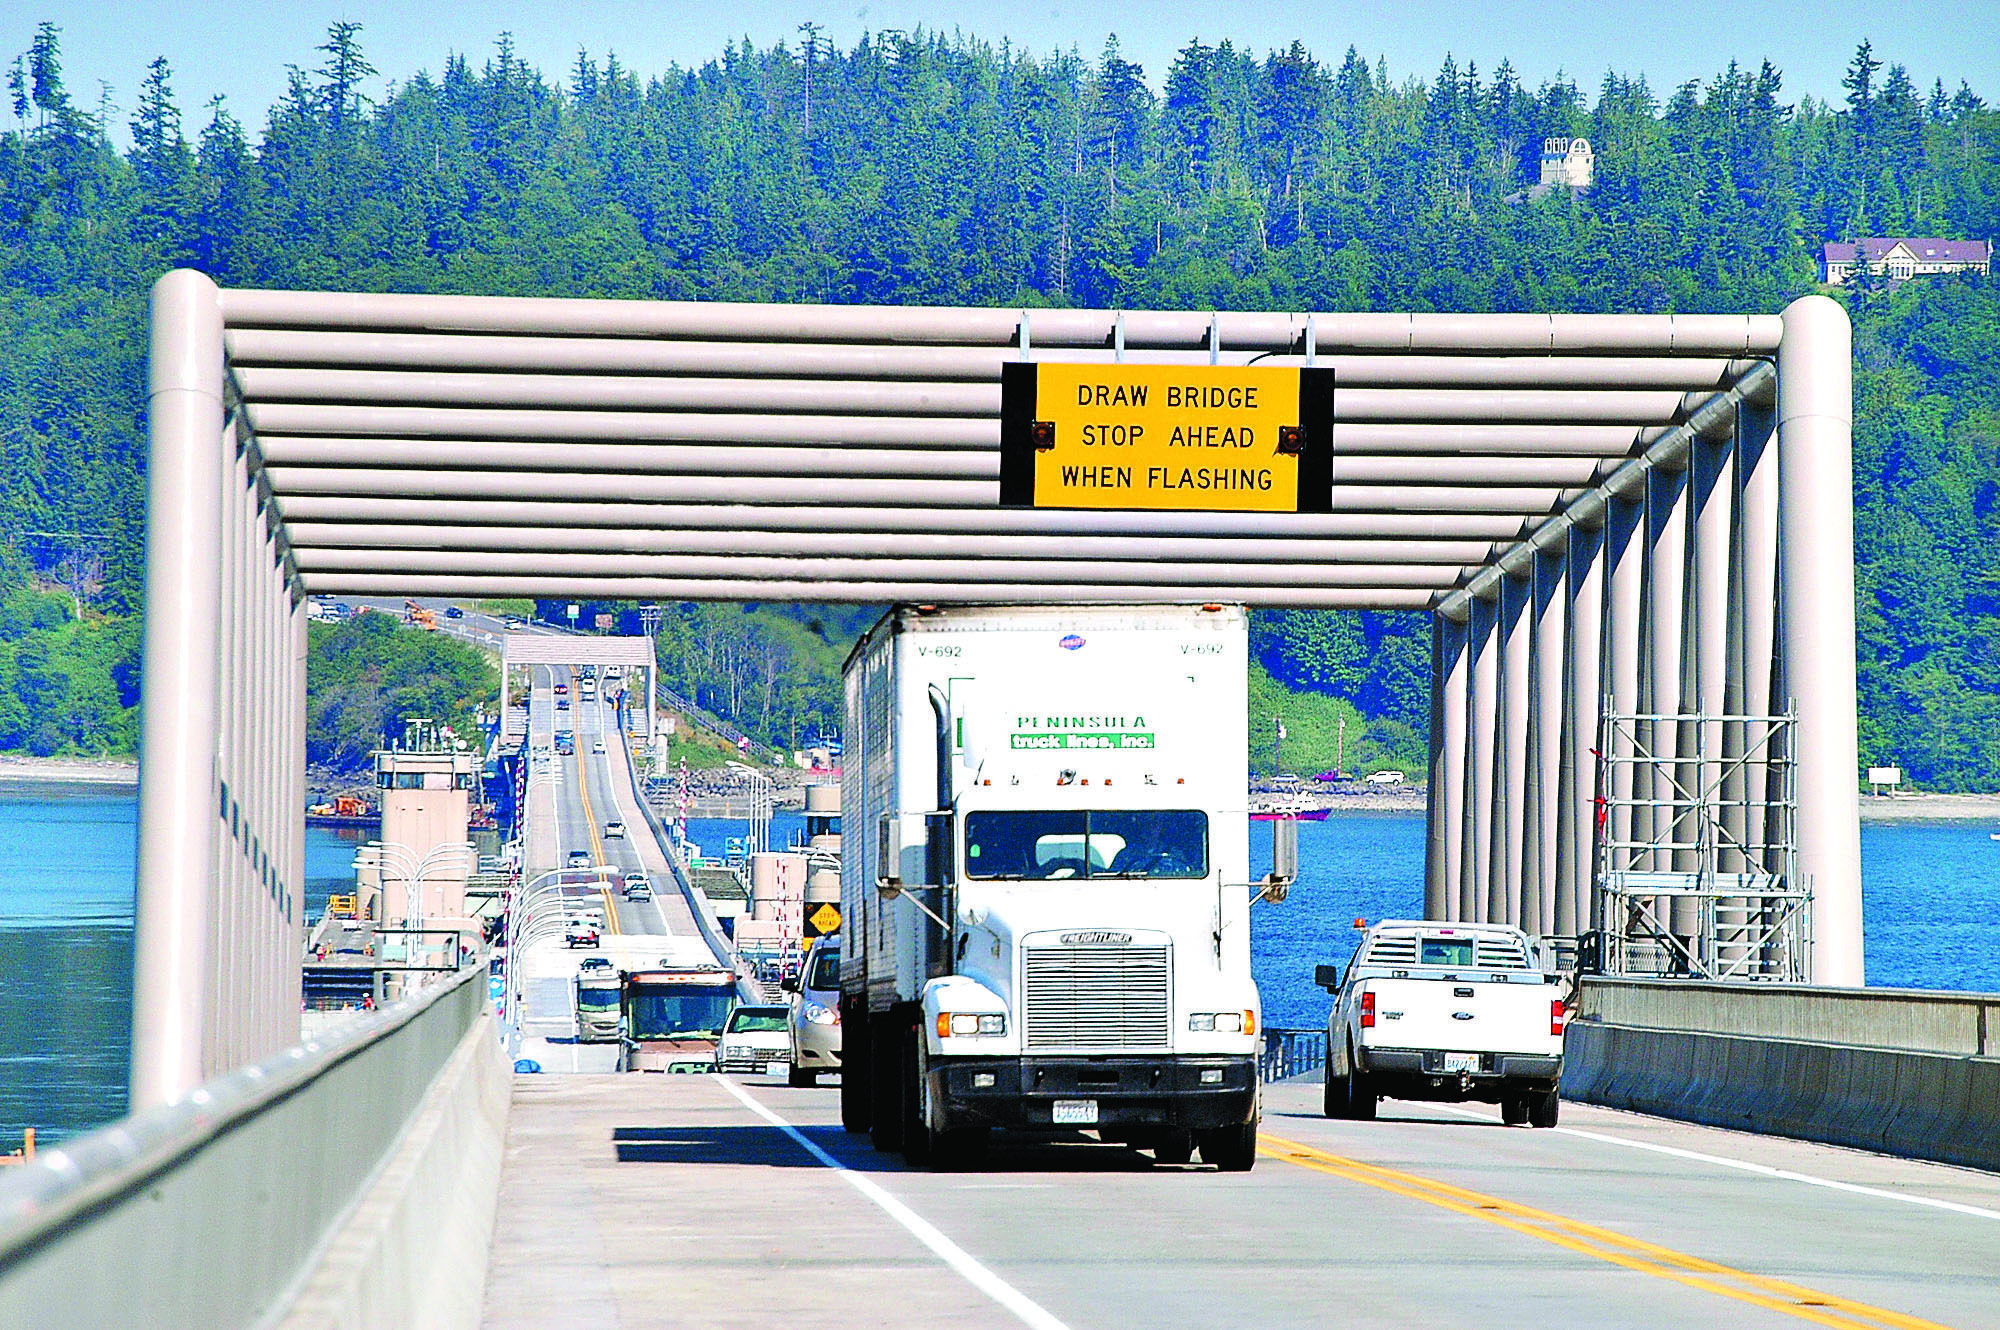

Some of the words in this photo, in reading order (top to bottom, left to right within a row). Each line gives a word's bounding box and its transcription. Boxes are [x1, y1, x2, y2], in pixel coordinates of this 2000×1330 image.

[1078, 384, 1148, 407] DRAW
[1167, 386, 1258, 409] BRIDGE
[1081, 424, 1144, 447] STOP
[1168, 426, 1254, 448] AHEAD
[1061, 465, 1132, 489] WHEN
[1148, 467, 1272, 491] FLASHING
[918, 645, 962, 658] V-692
[1180, 643, 1223, 655] V-692
[1017, 715, 1146, 729] PENINSULA
[1012, 734, 1060, 748] truck
[1120, 734, 1153, 748] inc.
[1061, 932, 1132, 944] FREIGHTLINER
